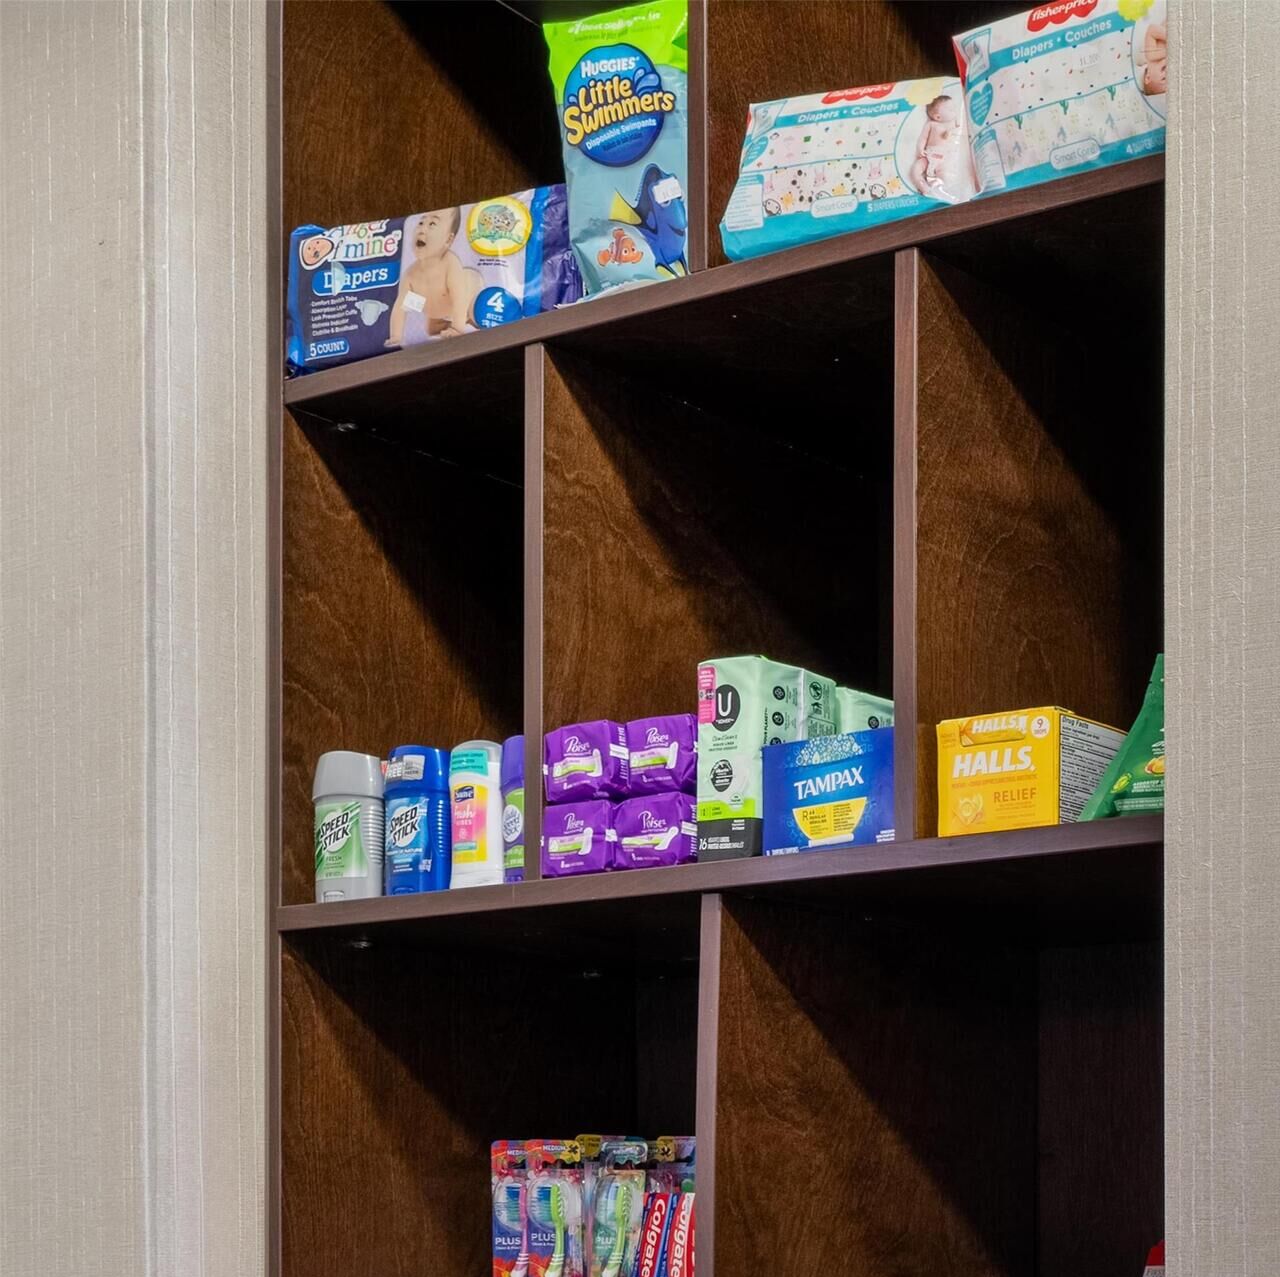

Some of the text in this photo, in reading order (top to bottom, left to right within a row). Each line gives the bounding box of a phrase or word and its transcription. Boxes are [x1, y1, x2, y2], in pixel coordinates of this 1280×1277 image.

[1012, 19, 1111, 60] Diapers Couches
[581, 57, 636, 78] HUGGIES
[579, 76, 632, 112] Little
[564, 92, 674, 144] Swimmers
[798, 102, 898, 123] Diapers Couches
[323, 268, 388, 289] Dapers
[487, 292, 505, 313] 4
[310, 341, 344, 356] 5 COUNT
[718, 691, 732, 716] U
[972, 715, 1022, 734] HALLS
[1037, 718, 1043, 729] 9
[952, 746, 1033, 779] HALLS
[794, 766, 865, 801] TAMPAX
[993, 788, 1037, 803] RELIEF
[320, 812, 349, 839] SPEED
[390, 807, 418, 833] SPEED
[322, 825, 350, 851] STICK
[392, 819, 418, 846] STICK
[495, 1237, 521, 1246] PLUS
[531, 1233, 556, 1242] PLUS
